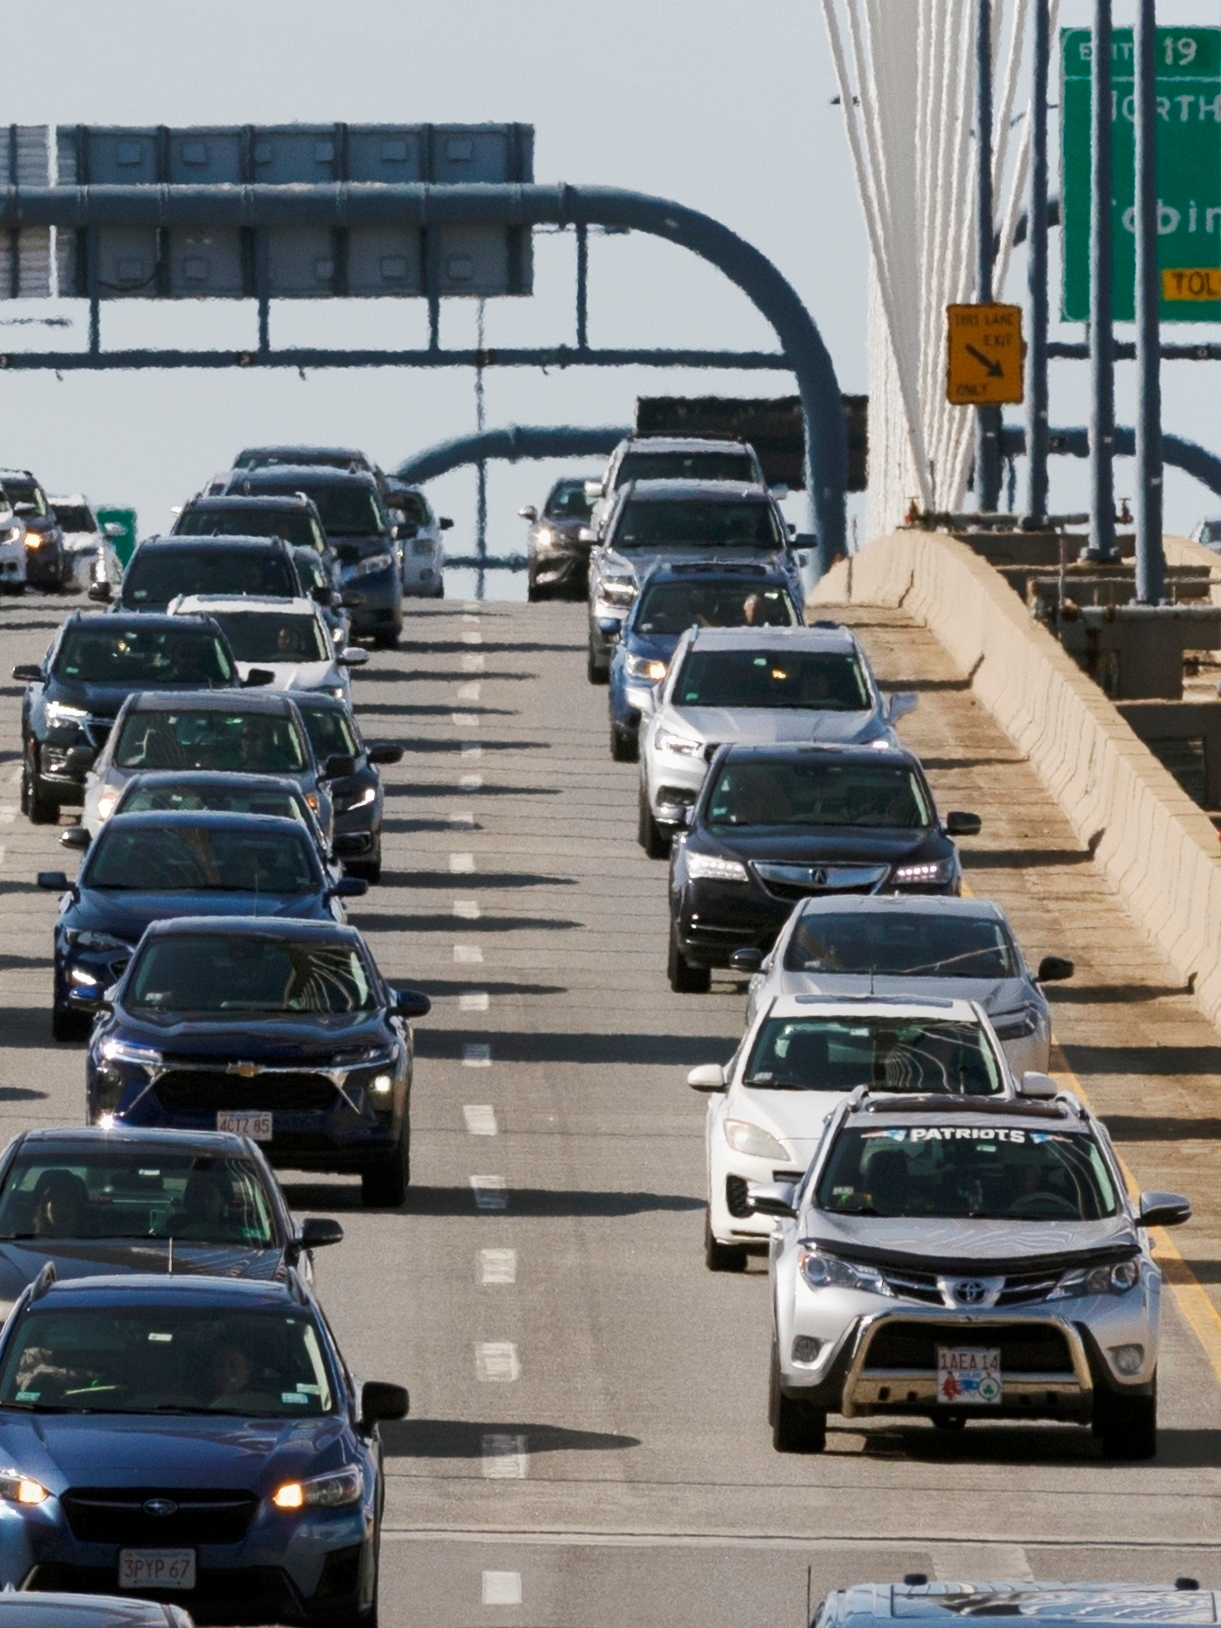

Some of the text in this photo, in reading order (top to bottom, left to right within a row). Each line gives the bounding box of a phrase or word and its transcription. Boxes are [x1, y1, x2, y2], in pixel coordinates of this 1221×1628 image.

[1079, 35, 1198, 66] EIT 19
[1110, 90, 1221, 123] ORTH
[1111, 199, 1221, 236] obin
[985, 312, 1015, 326] LANE
[983, 333, 1013, 347] EXIT
[955, 383, 989, 396] ONLY
[909, 1127, 1026, 1144] PATRIOTS
[940, 1352, 998, 1370] 1AEA 14
[123, 1559, 191, 1578] 3PYP 67
